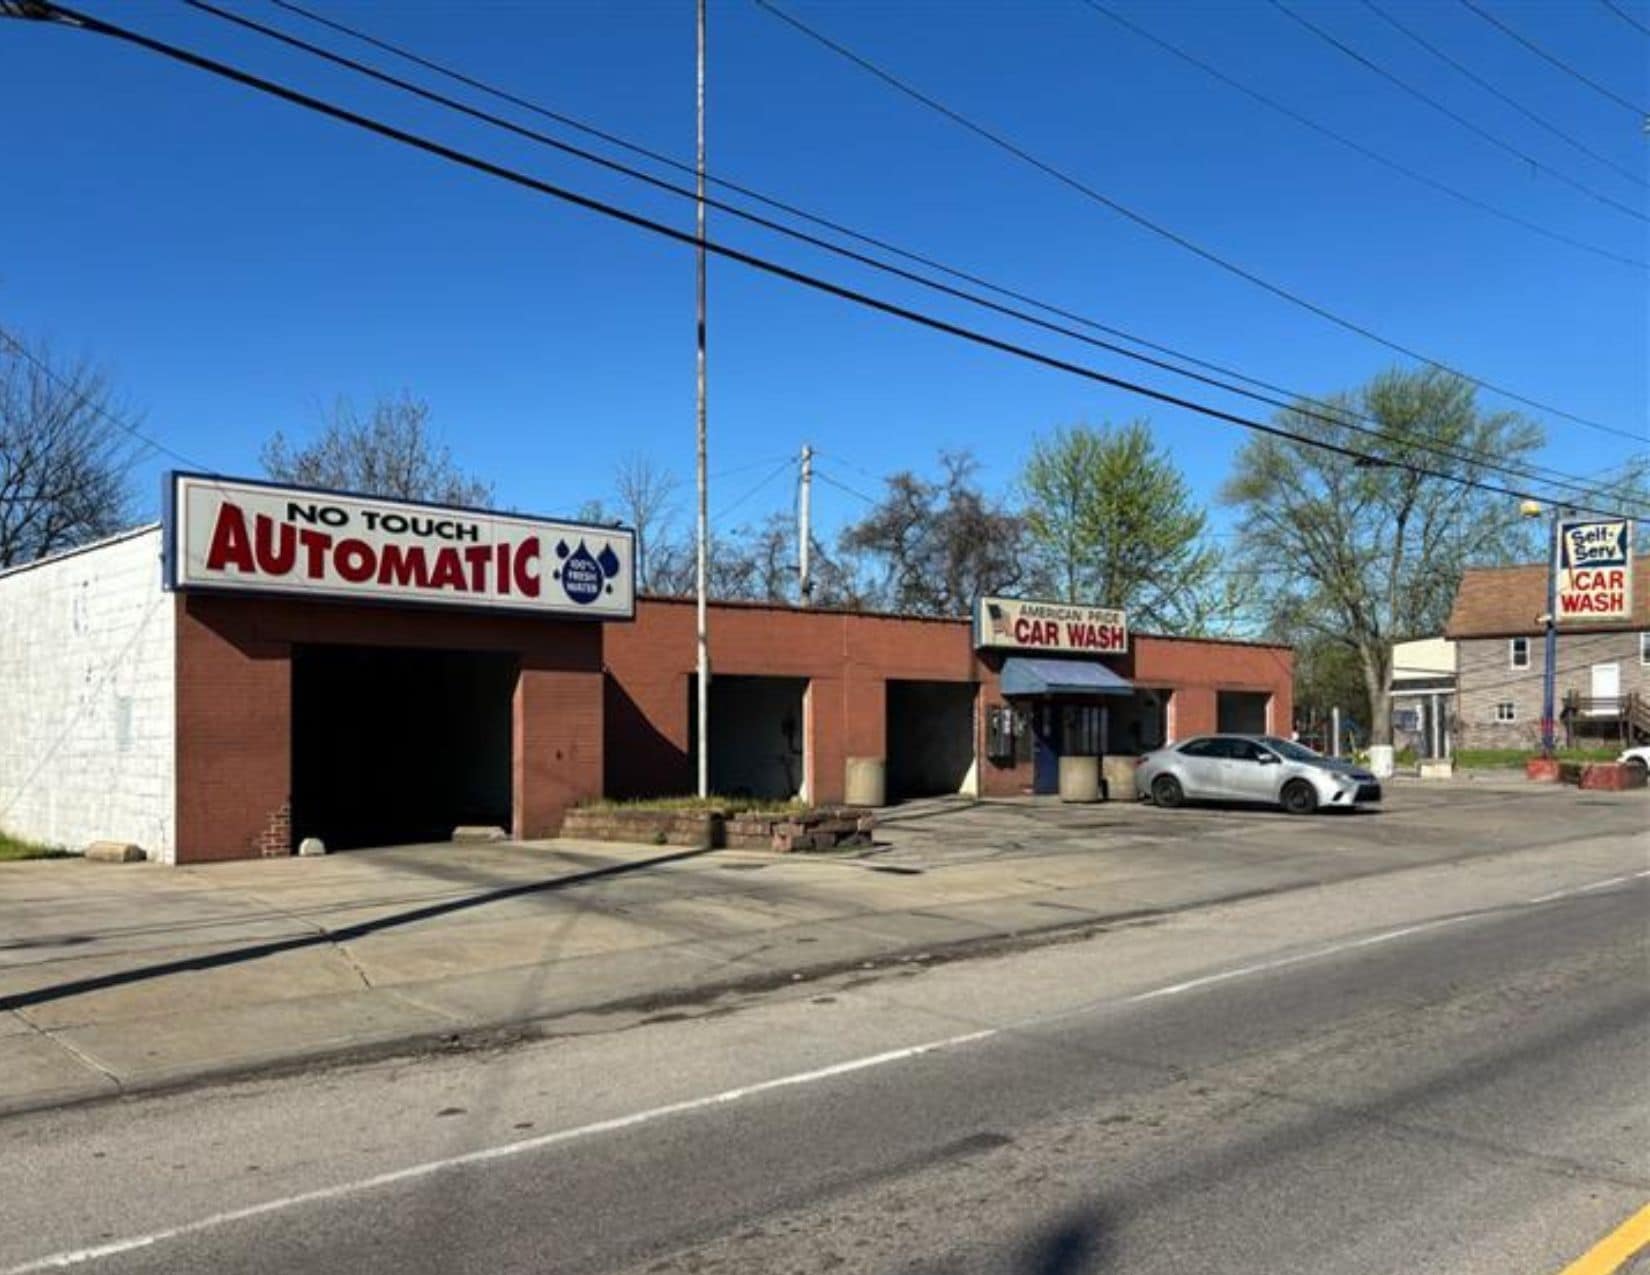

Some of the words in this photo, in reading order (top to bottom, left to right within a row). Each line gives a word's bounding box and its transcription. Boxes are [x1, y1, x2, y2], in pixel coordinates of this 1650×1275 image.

[287, 502, 349, 527] NO
[366, 511, 478, 542] TOUCH
[206, 502, 541, 599] AUTOMATIC
[1574, 543, 1616, 560] Serv
[567, 570, 598, 581] FRESH
[1575, 570, 1624, 591] CAR
[566, 582, 599, 593] WATER
[1561, 593, 1624, 612] WASH
[1019, 604, 1082, 621] AMERICAN
[1015, 618, 1059, 646] CAR
[1067, 622, 1124, 649] WASH
